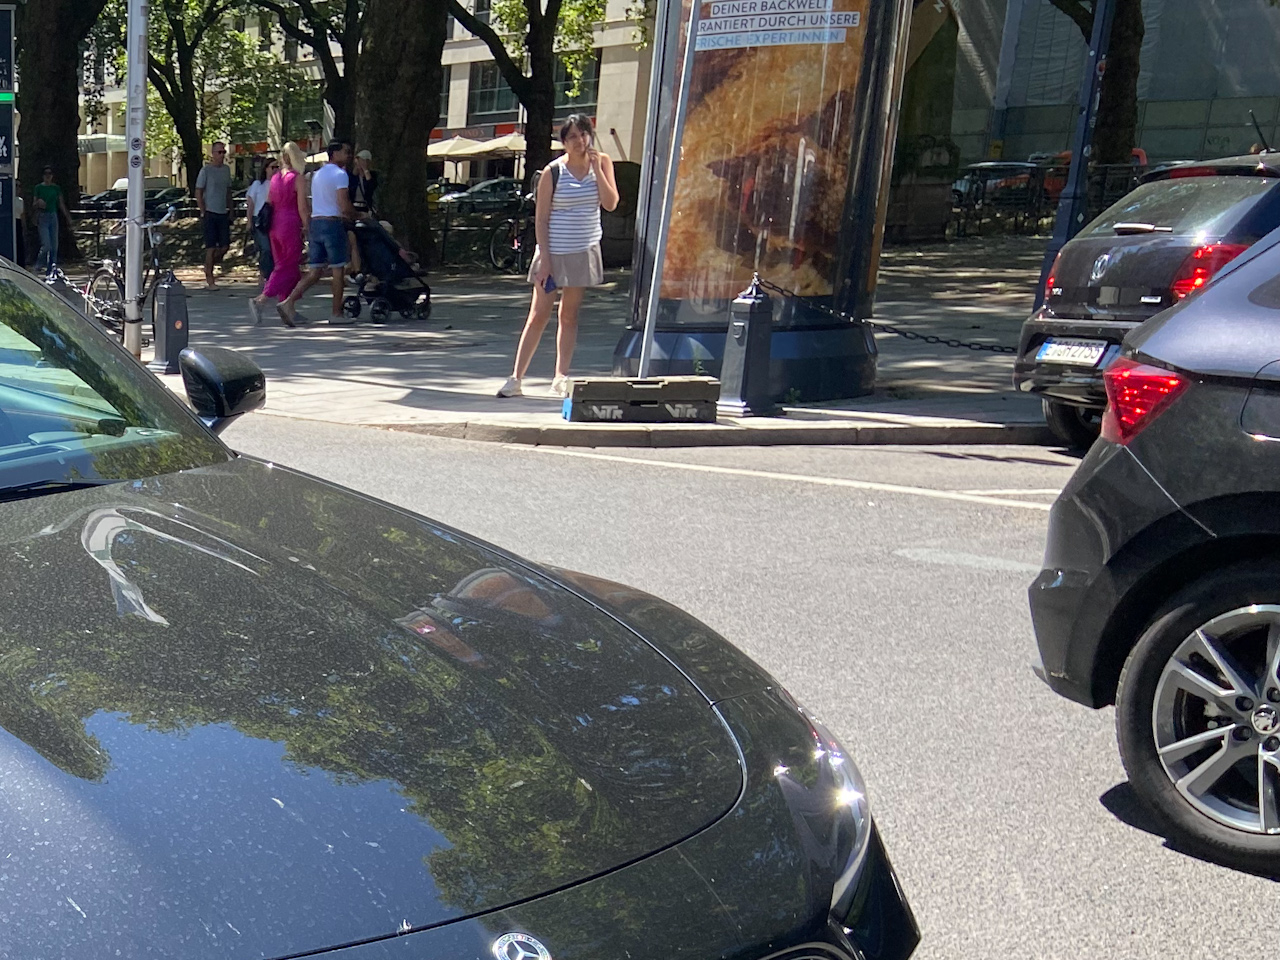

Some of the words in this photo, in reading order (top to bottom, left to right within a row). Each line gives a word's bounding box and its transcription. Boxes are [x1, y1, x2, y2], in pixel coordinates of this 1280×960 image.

[712, 1, 757, 15] DEINER
[758, 14, 806, 28] DURCH
[810, 13, 858, 26] UNSERE
